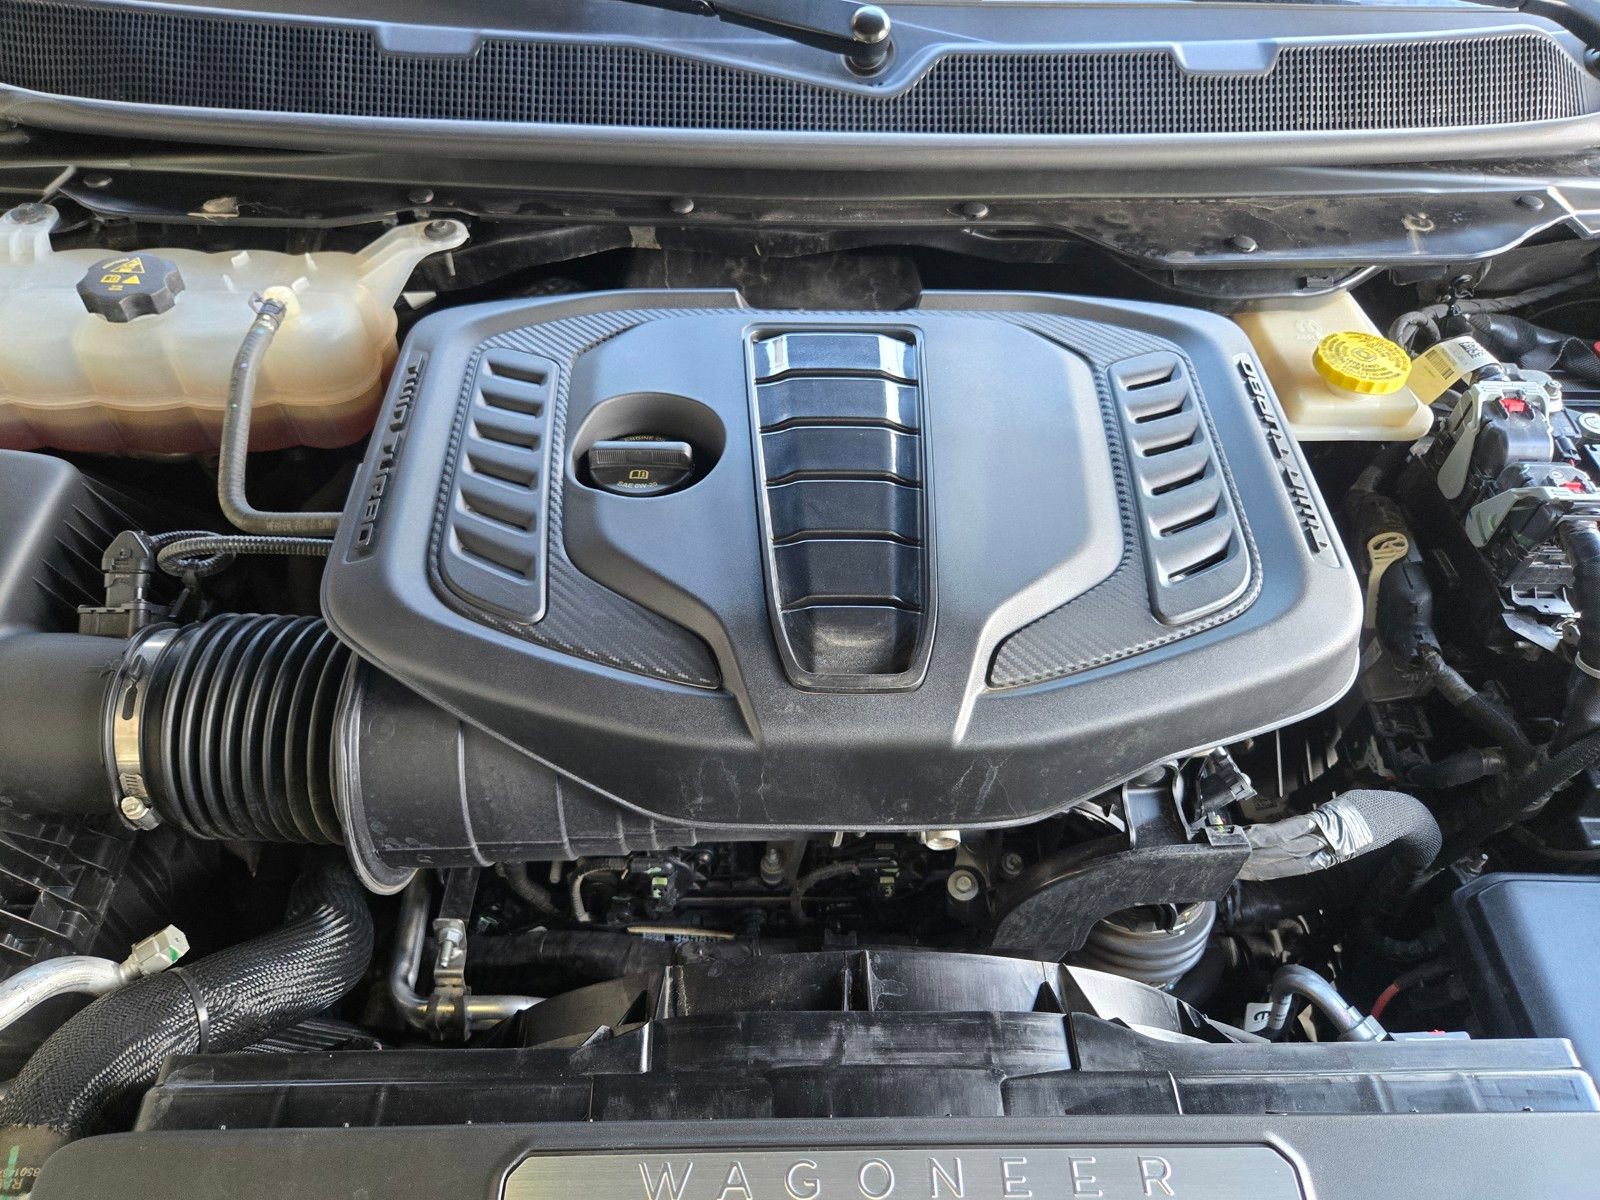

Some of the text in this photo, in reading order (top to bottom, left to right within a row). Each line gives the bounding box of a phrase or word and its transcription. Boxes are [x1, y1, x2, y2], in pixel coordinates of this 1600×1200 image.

[1238, 358, 1289, 460] TURBO
[356, 431, 402, 547] TURBO
[639, 1155, 1176, 1200] WAGONEER
